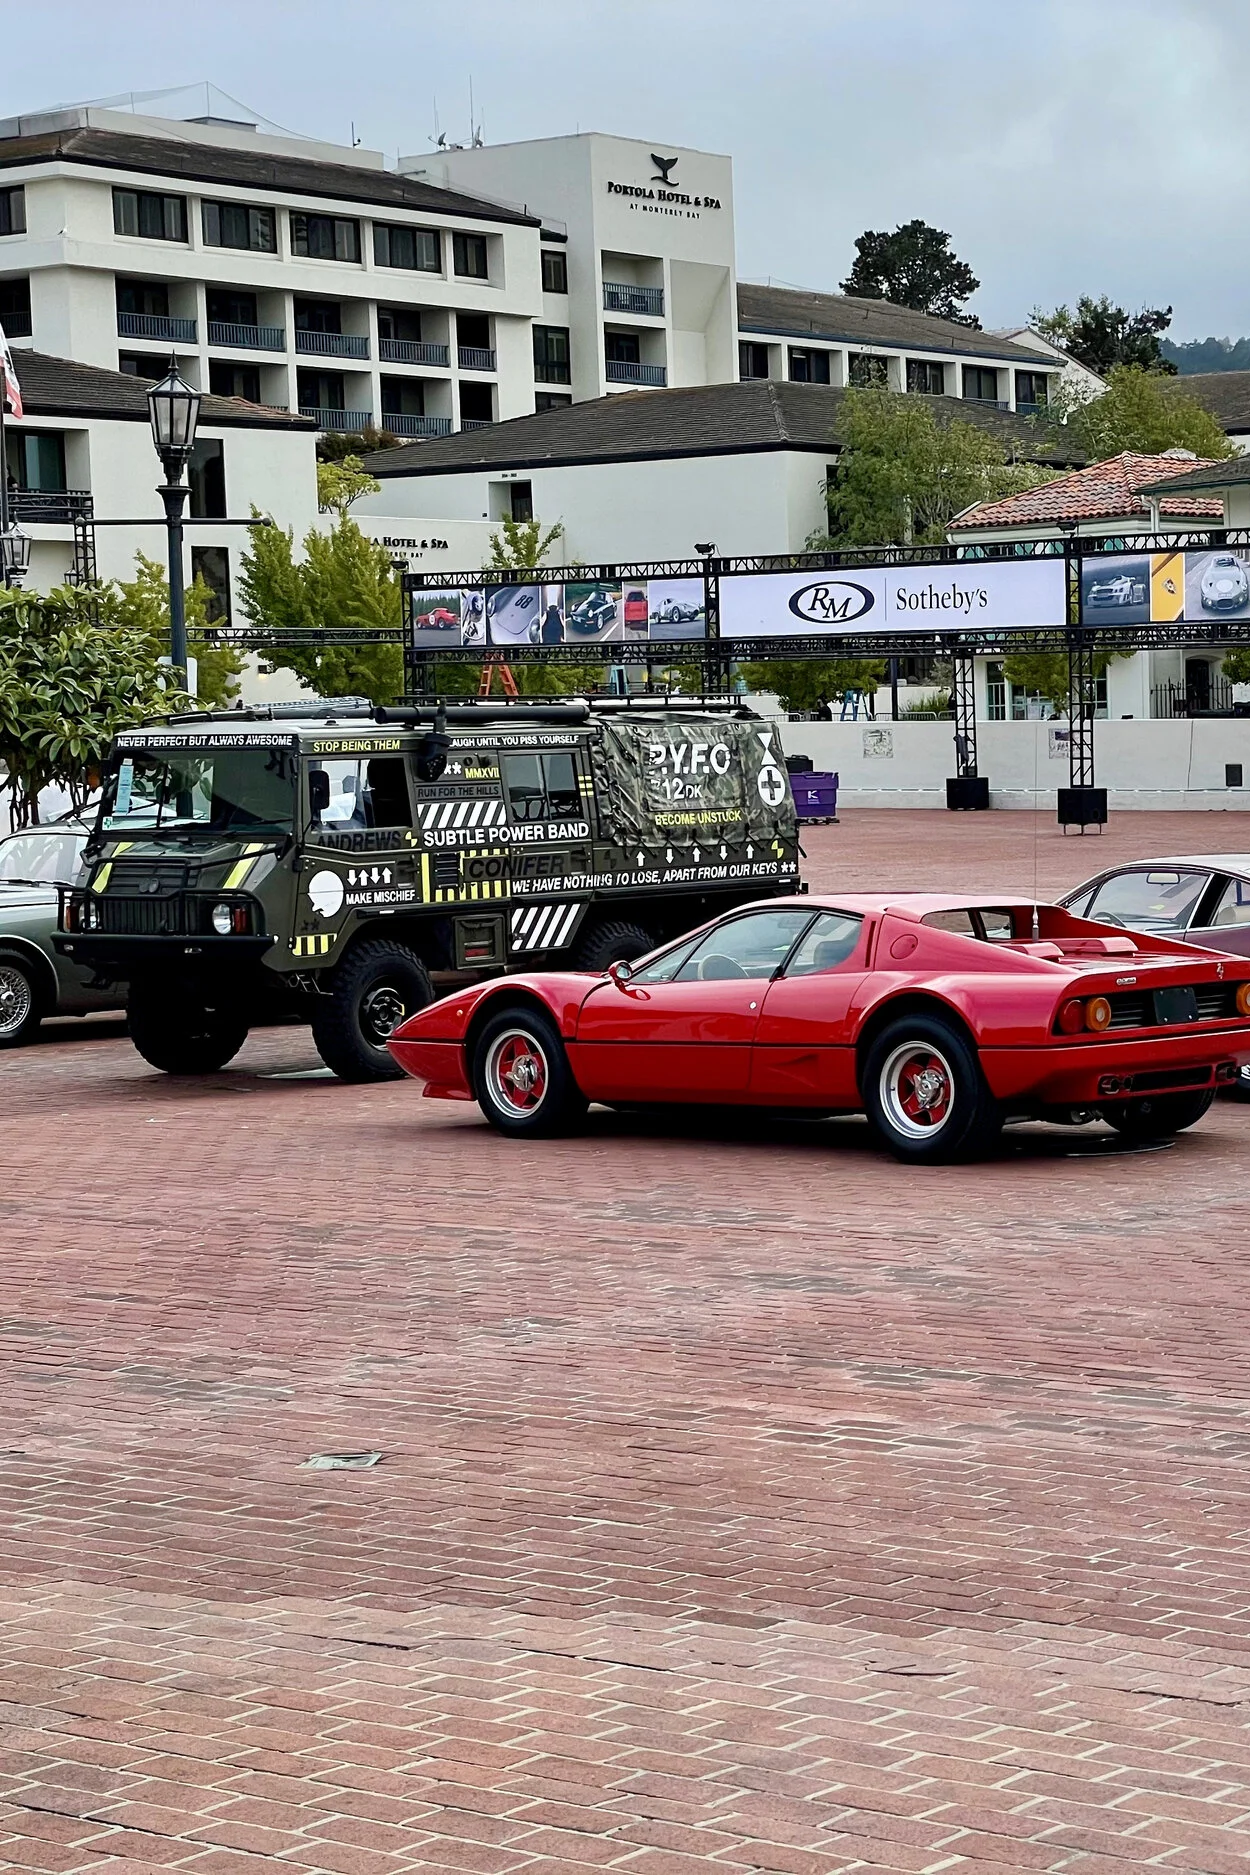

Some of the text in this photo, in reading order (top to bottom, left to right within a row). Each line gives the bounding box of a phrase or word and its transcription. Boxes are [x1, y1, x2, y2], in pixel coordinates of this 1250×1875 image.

[694, 197, 702, 206] &
[642, 205, 683, 217] MONTEREY
[687, 211, 700, 219] BAY
[421, 540, 428, 549] &
[514, 594, 533, 610] 88
[807, 587, 852, 619] RM
[896, 583, 988, 614] Sotheby's
[117, 735, 293, 747] NEVER PERFECT BUT ALWAYS AWESOME
[313, 740, 400, 752] STOP BEING THEM
[476, 737, 500, 746] UNTIL
[502, 736, 519, 745] YOU
[520, 736, 538, 744] PISS
[538, 735, 579, 744] YOURSELF
[465, 767, 500, 779] MMXVII
[418, 785, 499, 798] RUN FOR THE HILLS
[655, 810, 742, 825] BECOME UNSTUCK
[317, 830, 401, 850] ANDREWS
[423, 823, 589, 847] SUBTLE POWER BAND
[469, 855, 565, 878] CONIFER
[512, 879, 530, 893] WE
[532, 877, 562, 892] HAVE
[631, 867, 661, 884] LOSE,
[662, 867, 697, 882] APART
[697, 865, 728, 880] FROM
[732, 863, 750, 877] OUR
[752, 861, 778, 875] KEYS
[346, 890, 416, 905] MAKE MISCHIEF
